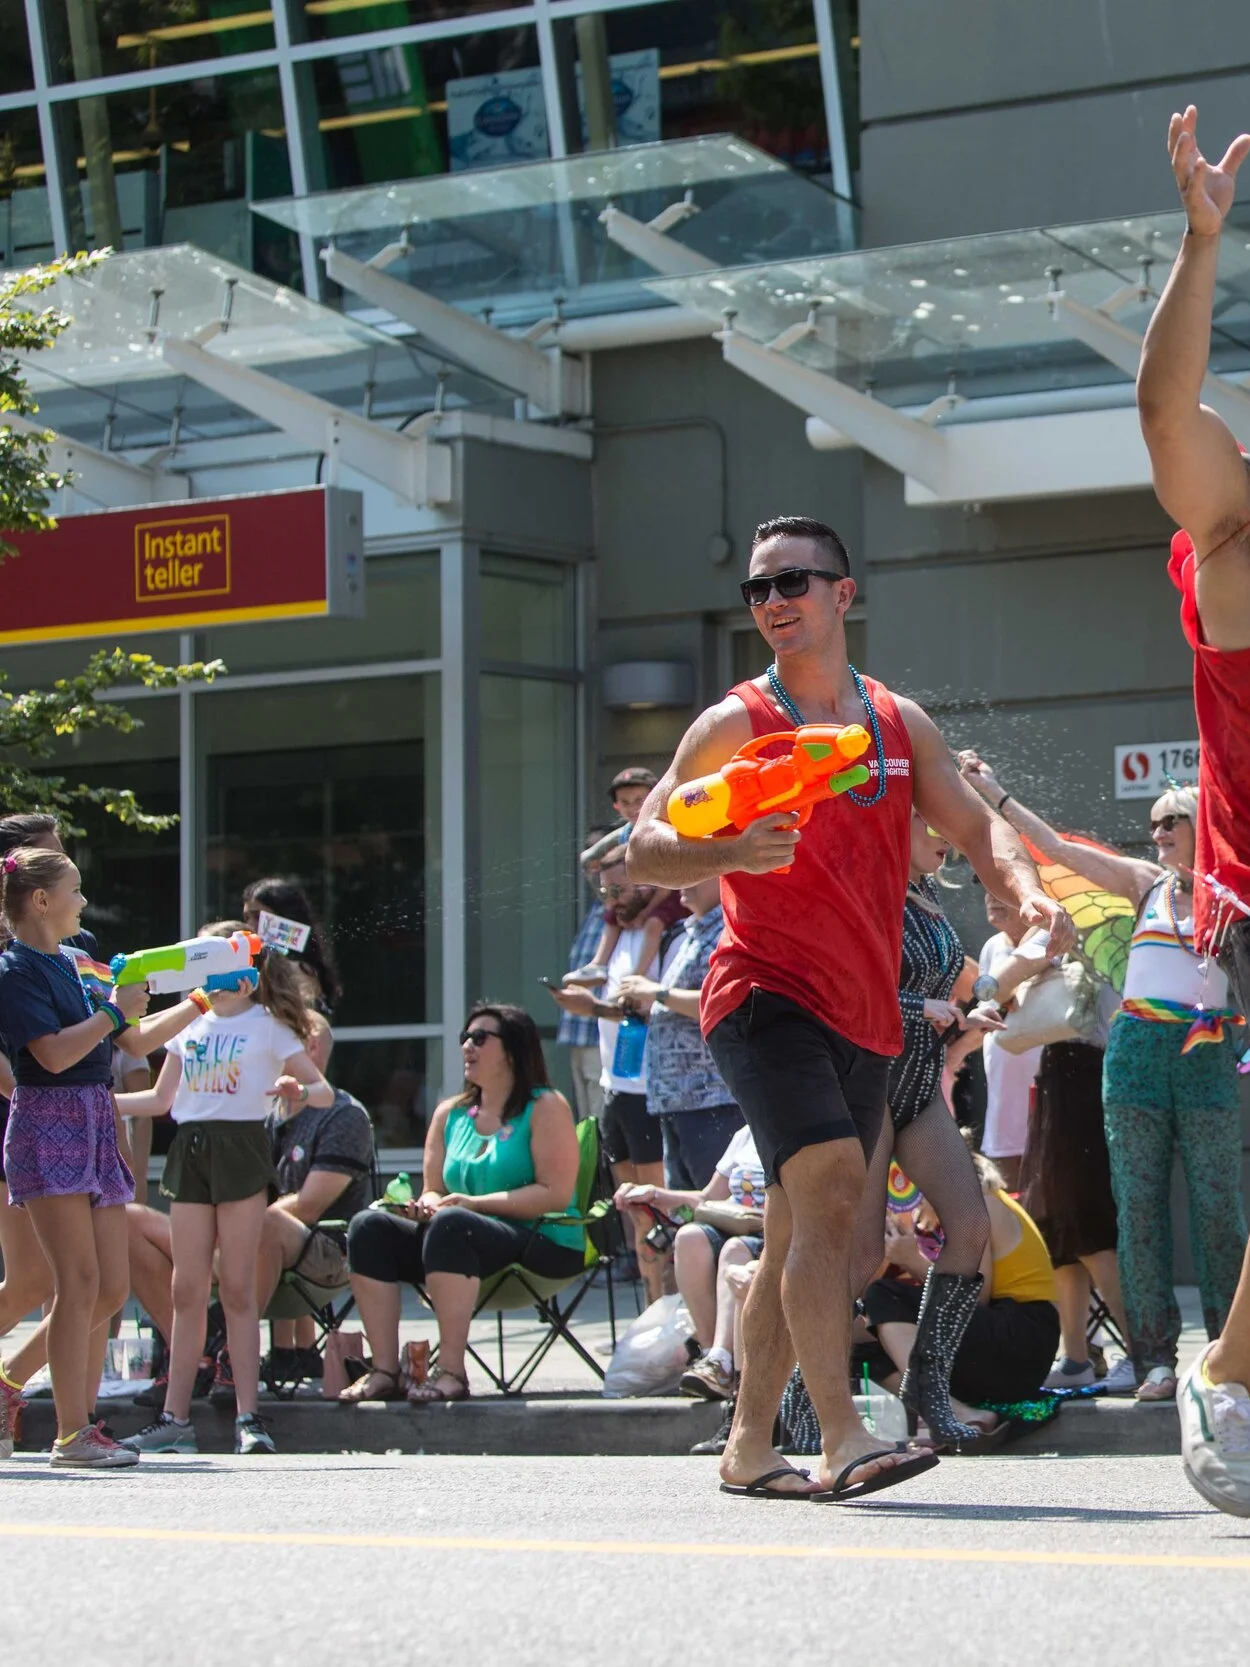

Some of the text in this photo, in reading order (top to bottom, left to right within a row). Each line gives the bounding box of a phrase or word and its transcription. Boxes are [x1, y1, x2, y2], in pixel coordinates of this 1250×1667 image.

[144, 526, 222, 561] Instant
[144, 560, 204, 591] teller
[868, 758, 910, 769] VACOUVER
[869, 767, 910, 777] FIRFIGHTERS
[186, 1033, 248, 1064] OVE
